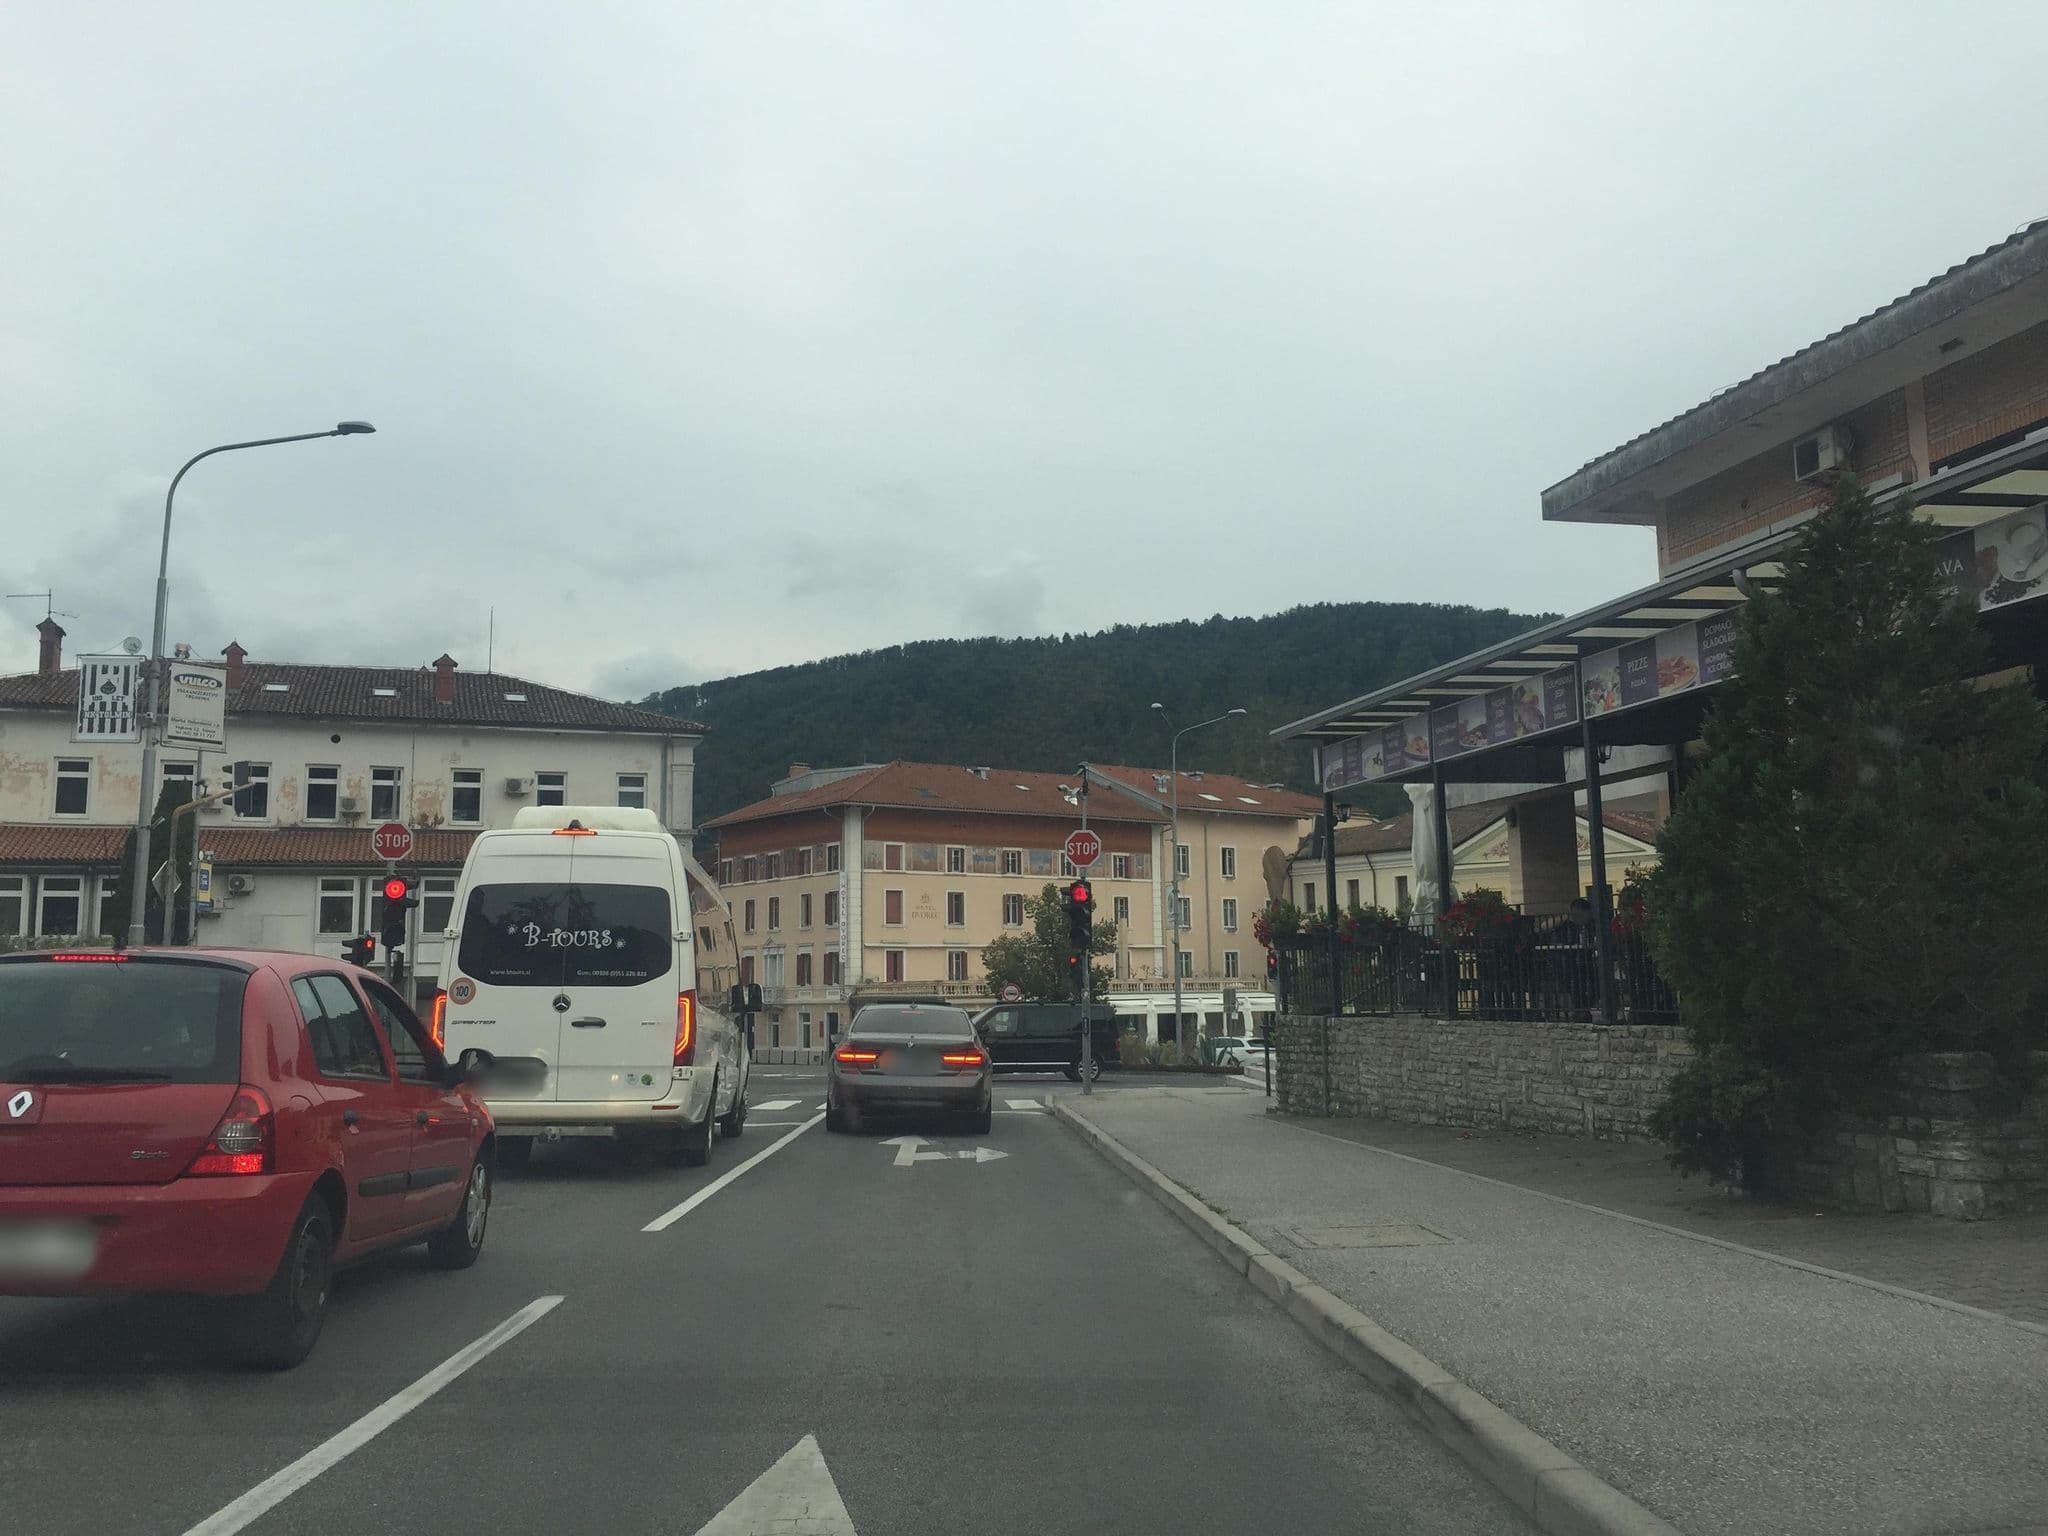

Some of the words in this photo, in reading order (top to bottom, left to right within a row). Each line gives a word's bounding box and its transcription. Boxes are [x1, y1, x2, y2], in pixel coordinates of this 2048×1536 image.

[1626, 656, 1649, 673] PIZZE
[179, 675, 218, 689] VULCO
[375, 833, 410, 848] STOP
[1068, 842, 1098, 856] STOP
[522, 921, 613, 949] B-TOURS
[455, 985, 469, 997] 100
